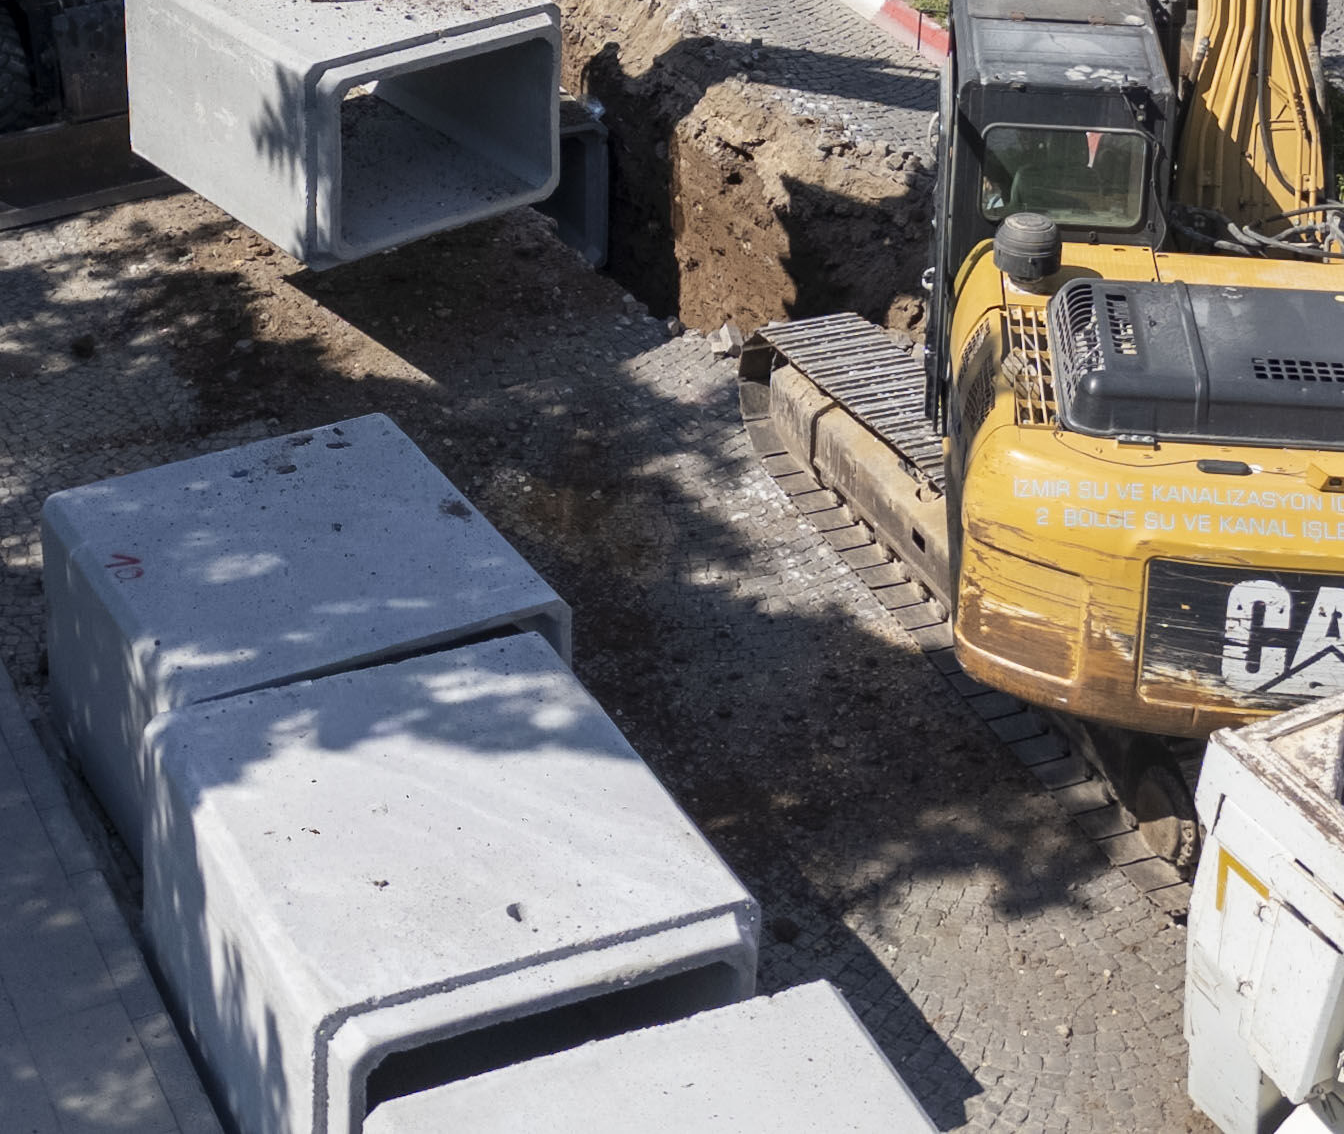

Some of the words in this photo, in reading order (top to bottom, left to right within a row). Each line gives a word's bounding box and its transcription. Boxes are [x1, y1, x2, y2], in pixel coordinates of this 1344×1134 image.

[1077, 479, 1109, 501] SU
[1116, 482, 1145, 502] VE
[1143, 510, 1176, 531] SU
[1183, 511, 1211, 533] VE
[1218, 514, 1295, 538] KANAL
